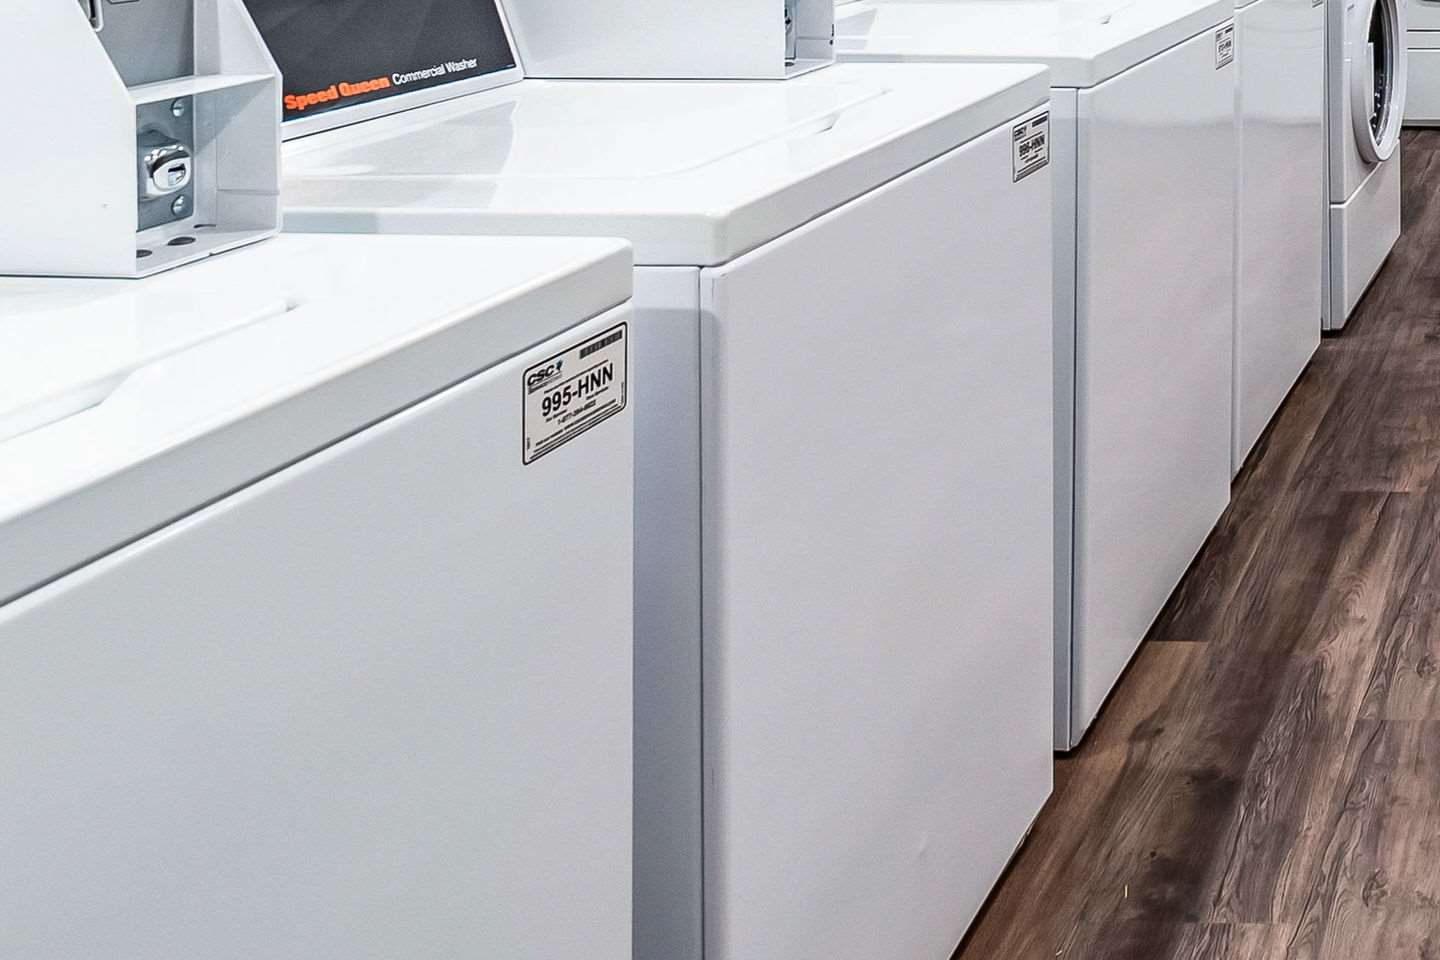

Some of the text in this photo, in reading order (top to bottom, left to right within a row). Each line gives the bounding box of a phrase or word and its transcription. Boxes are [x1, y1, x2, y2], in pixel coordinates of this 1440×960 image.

[284, 58, 478, 111] Speed Queen Commercial Washer
[528, 365, 555, 386] CSC
[541, 362, 614, 417] 995-HNN
